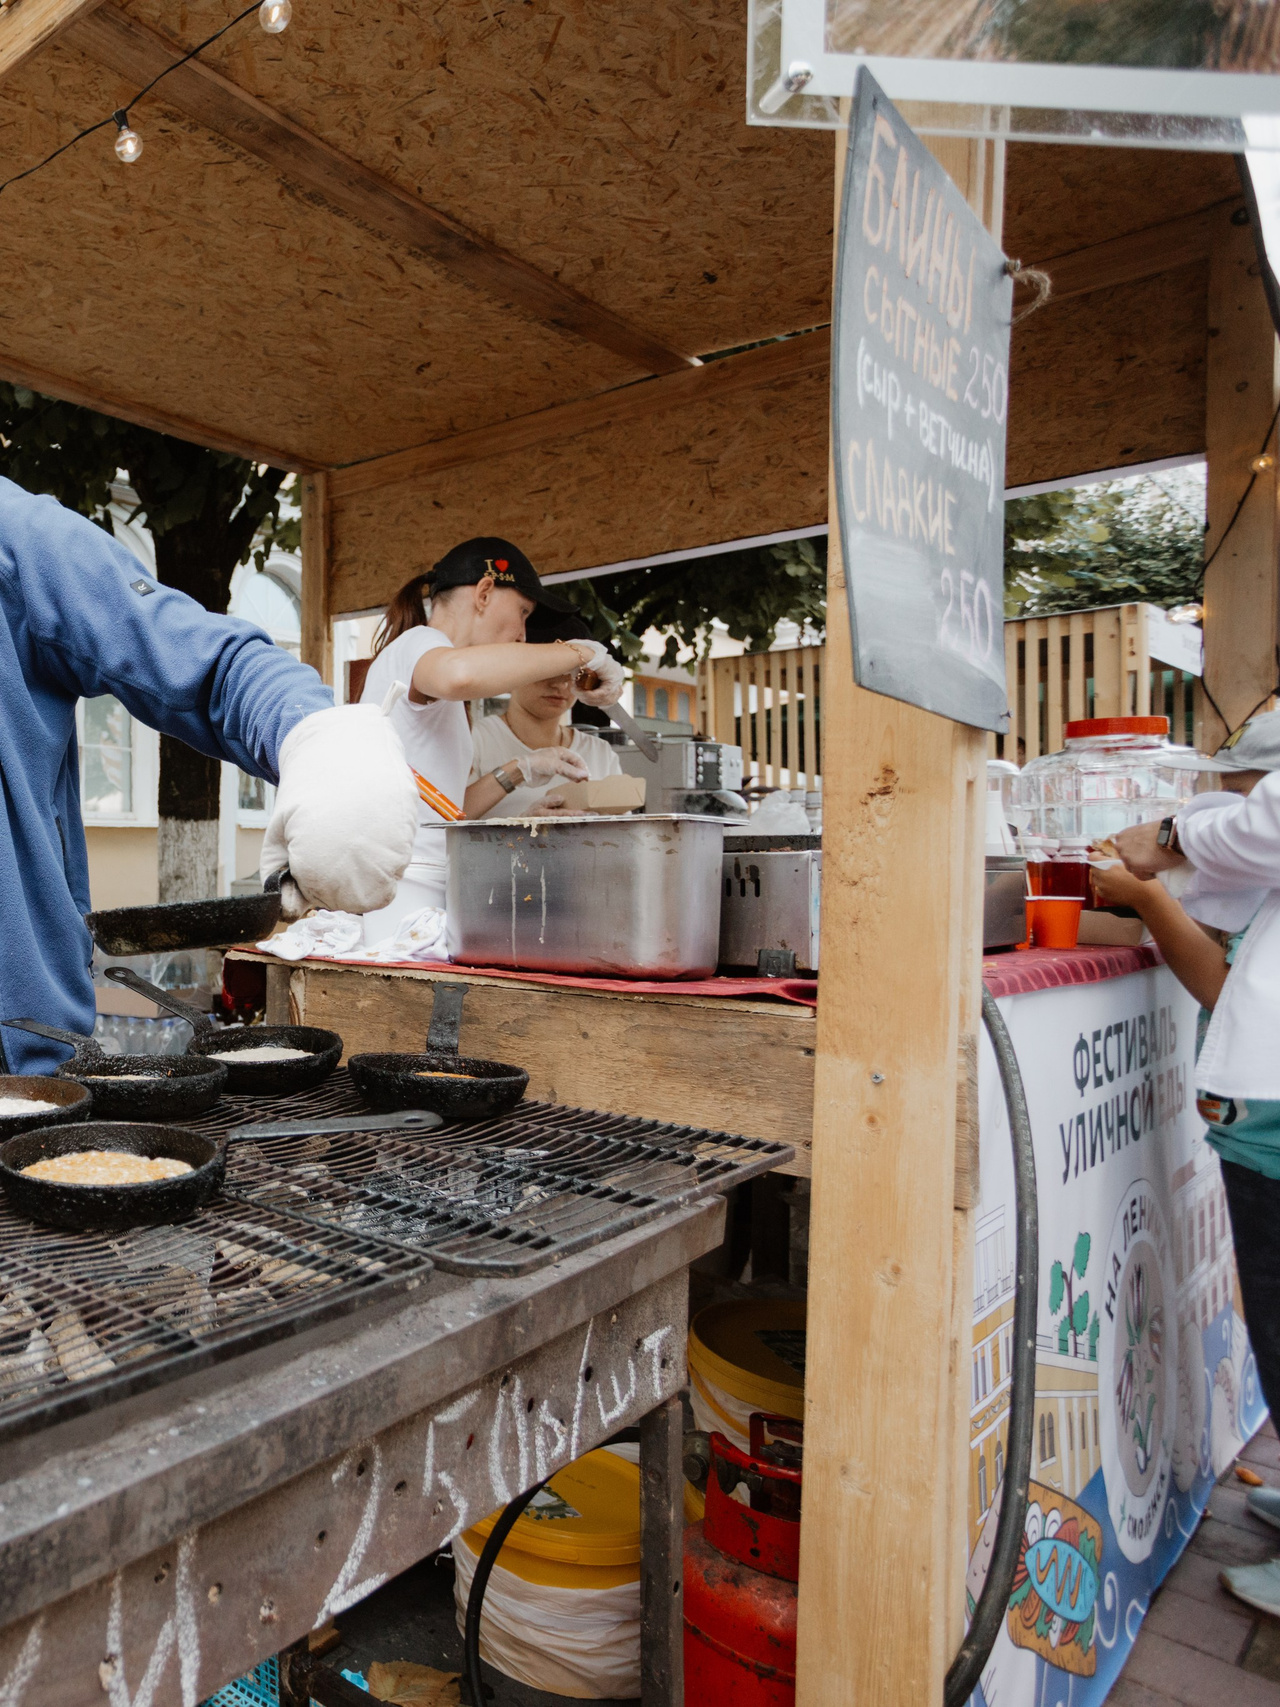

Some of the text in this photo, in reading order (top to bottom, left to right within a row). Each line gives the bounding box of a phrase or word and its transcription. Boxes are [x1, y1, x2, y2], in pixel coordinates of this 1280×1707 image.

[862, 113, 977, 336] БЛИНЫ
[863, 265, 1008, 425] СЫТНЫЕ 250
[940, 567, 994, 660] 250
[1073, 1005, 1177, 1097] ФЕСТИВАЛЬ
[1058, 1062, 1188, 1185] УЛИЧНОЙ ЕДЫ
[1104, 1250, 1121, 1322] НА
